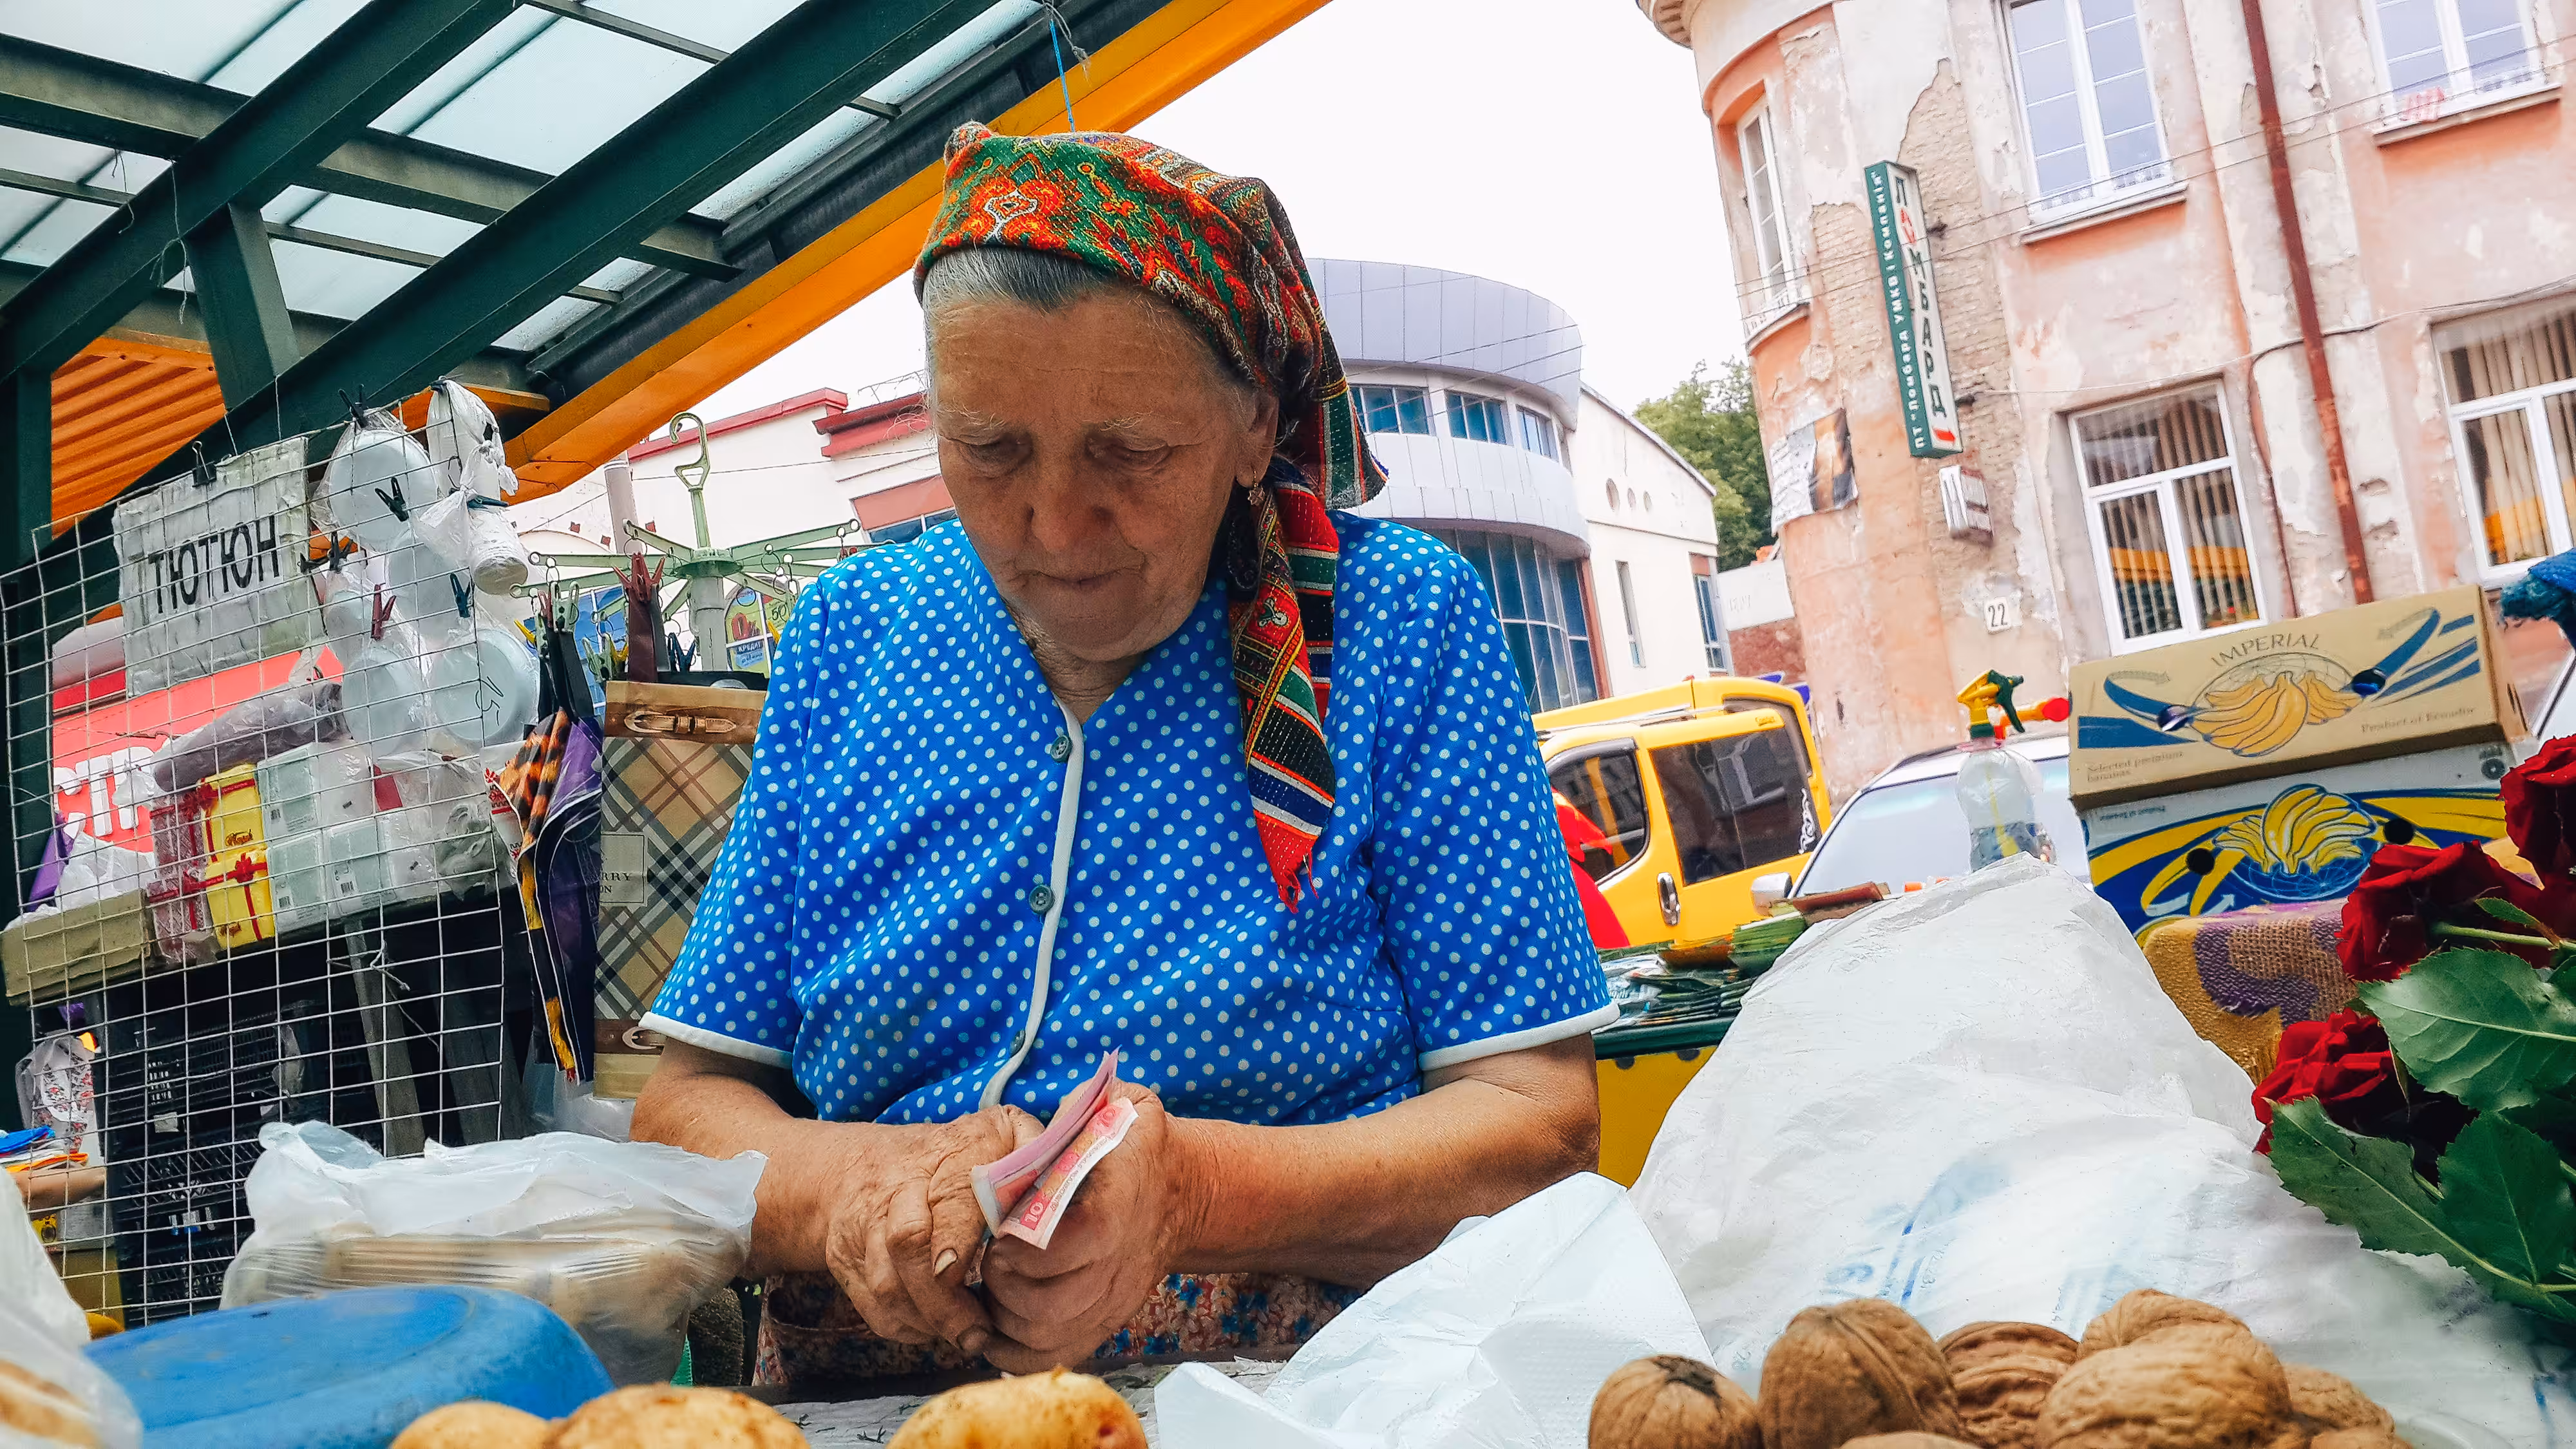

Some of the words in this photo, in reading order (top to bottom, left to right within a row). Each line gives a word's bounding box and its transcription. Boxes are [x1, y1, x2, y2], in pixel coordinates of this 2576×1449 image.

[147, 515, 280, 614] ТЮТЮН
[1987, 603, 2008, 627] 22
[2211, 632, 2319, 667] IMPERIAL
[1024, 1202, 1045, 1223] 10
